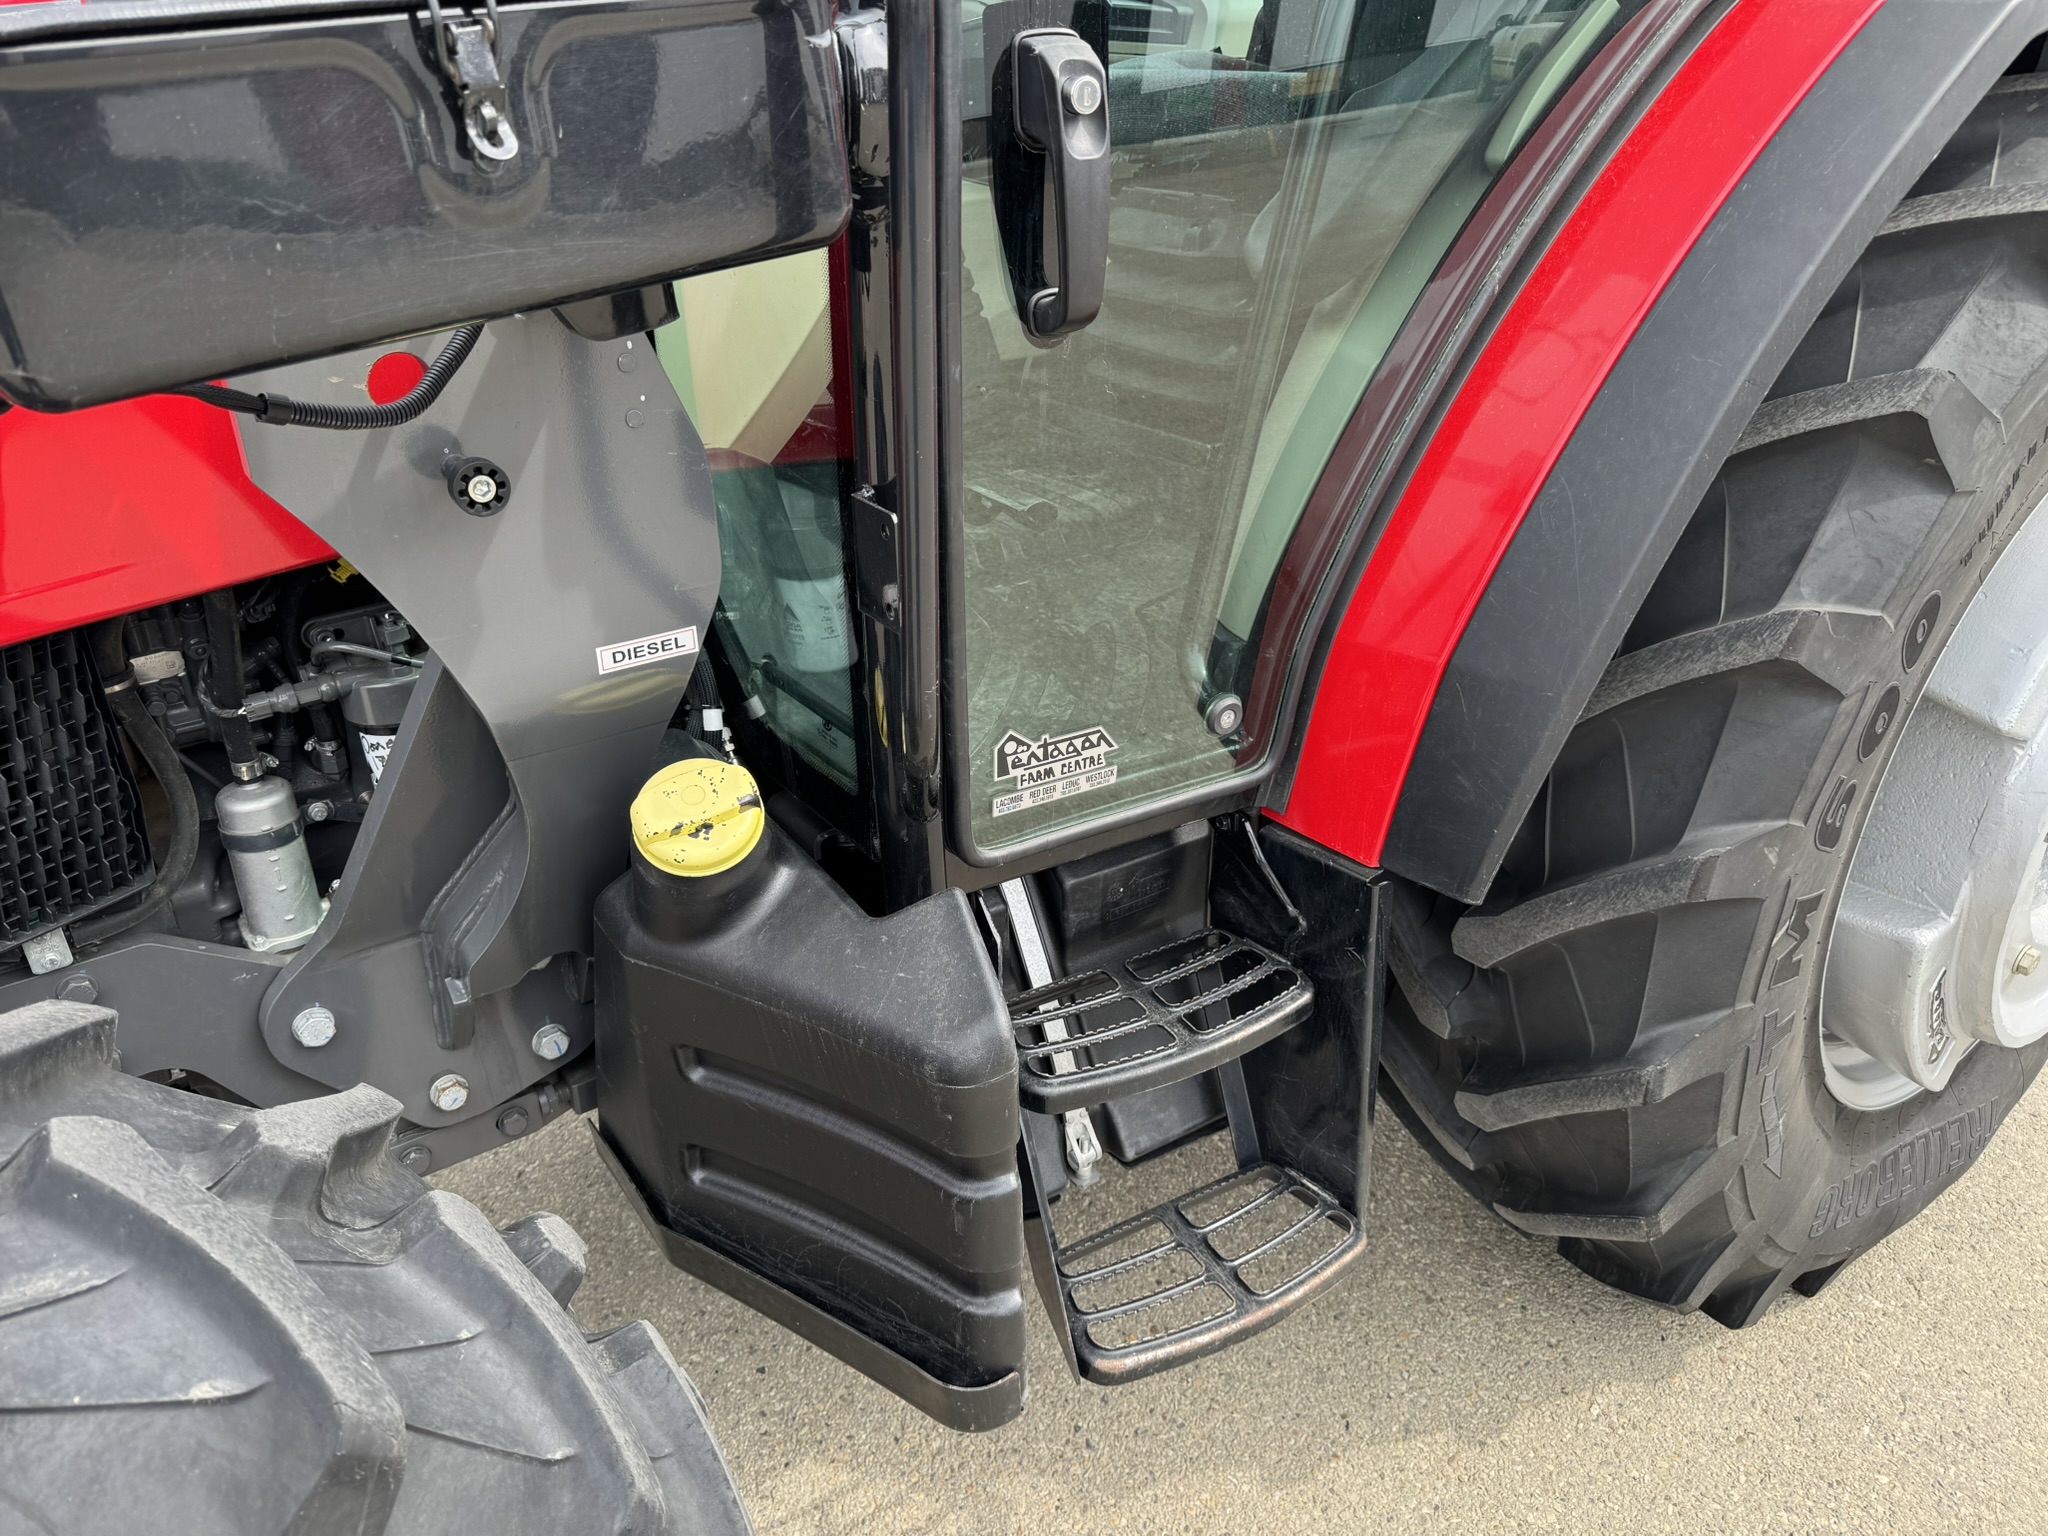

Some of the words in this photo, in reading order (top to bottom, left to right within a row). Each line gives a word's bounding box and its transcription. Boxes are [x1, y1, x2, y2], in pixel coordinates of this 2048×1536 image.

[612, 637, 686, 664] DIESEL
[997, 729, 1114, 778] Pentagon
[1020, 767, 1055, 786] FARM
[1061, 754, 1103, 775] CENTRE
[995, 793, 1024, 809] LACOMBE
[1030, 788, 1041, 799] RED
[1042, 785, 1057, 796] DEER
[1062, 778, 1081, 791] LEDUC
[1085, 768, 1115, 783] WESTLOCK
[1808, 1096, 1999, 1239] TRELLEBORG
